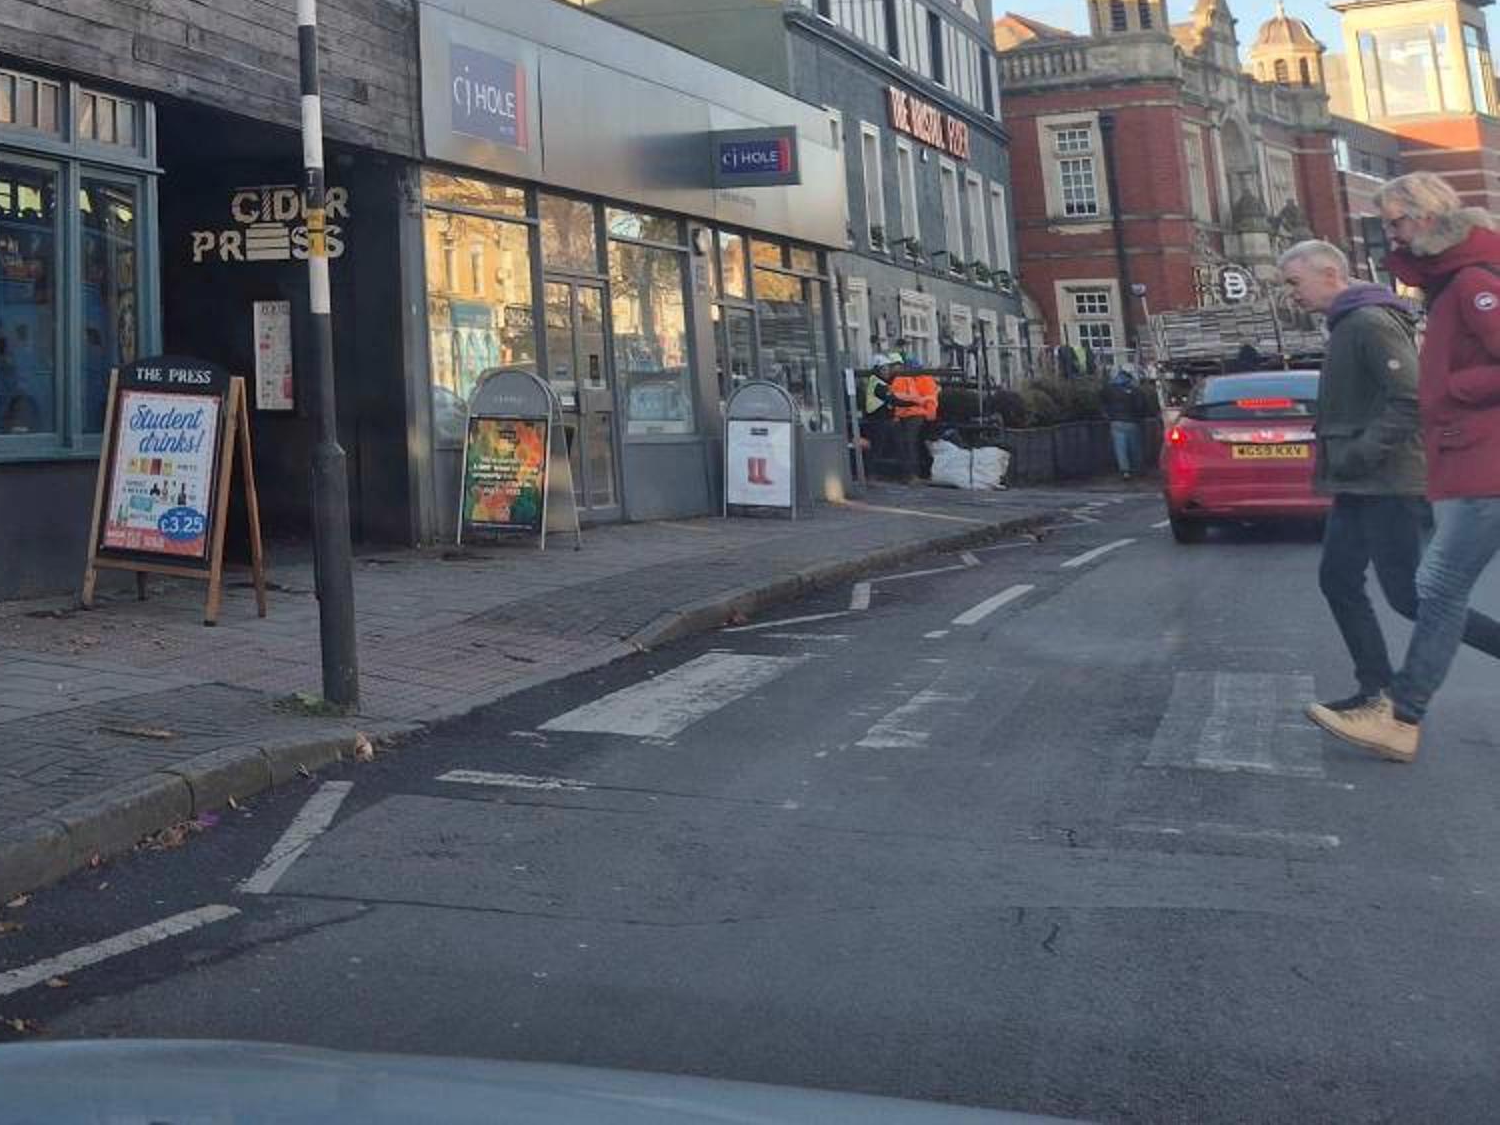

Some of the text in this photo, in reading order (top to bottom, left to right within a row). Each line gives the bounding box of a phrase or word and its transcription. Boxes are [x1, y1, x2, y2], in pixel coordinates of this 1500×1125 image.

[475, 82, 517, 119] HOLE
[741, 149, 780, 165] HOLE
[136, 368, 213, 385] THE PRESS
[130, 404, 205, 432] Student
[138, 429, 206, 455] drinks!
